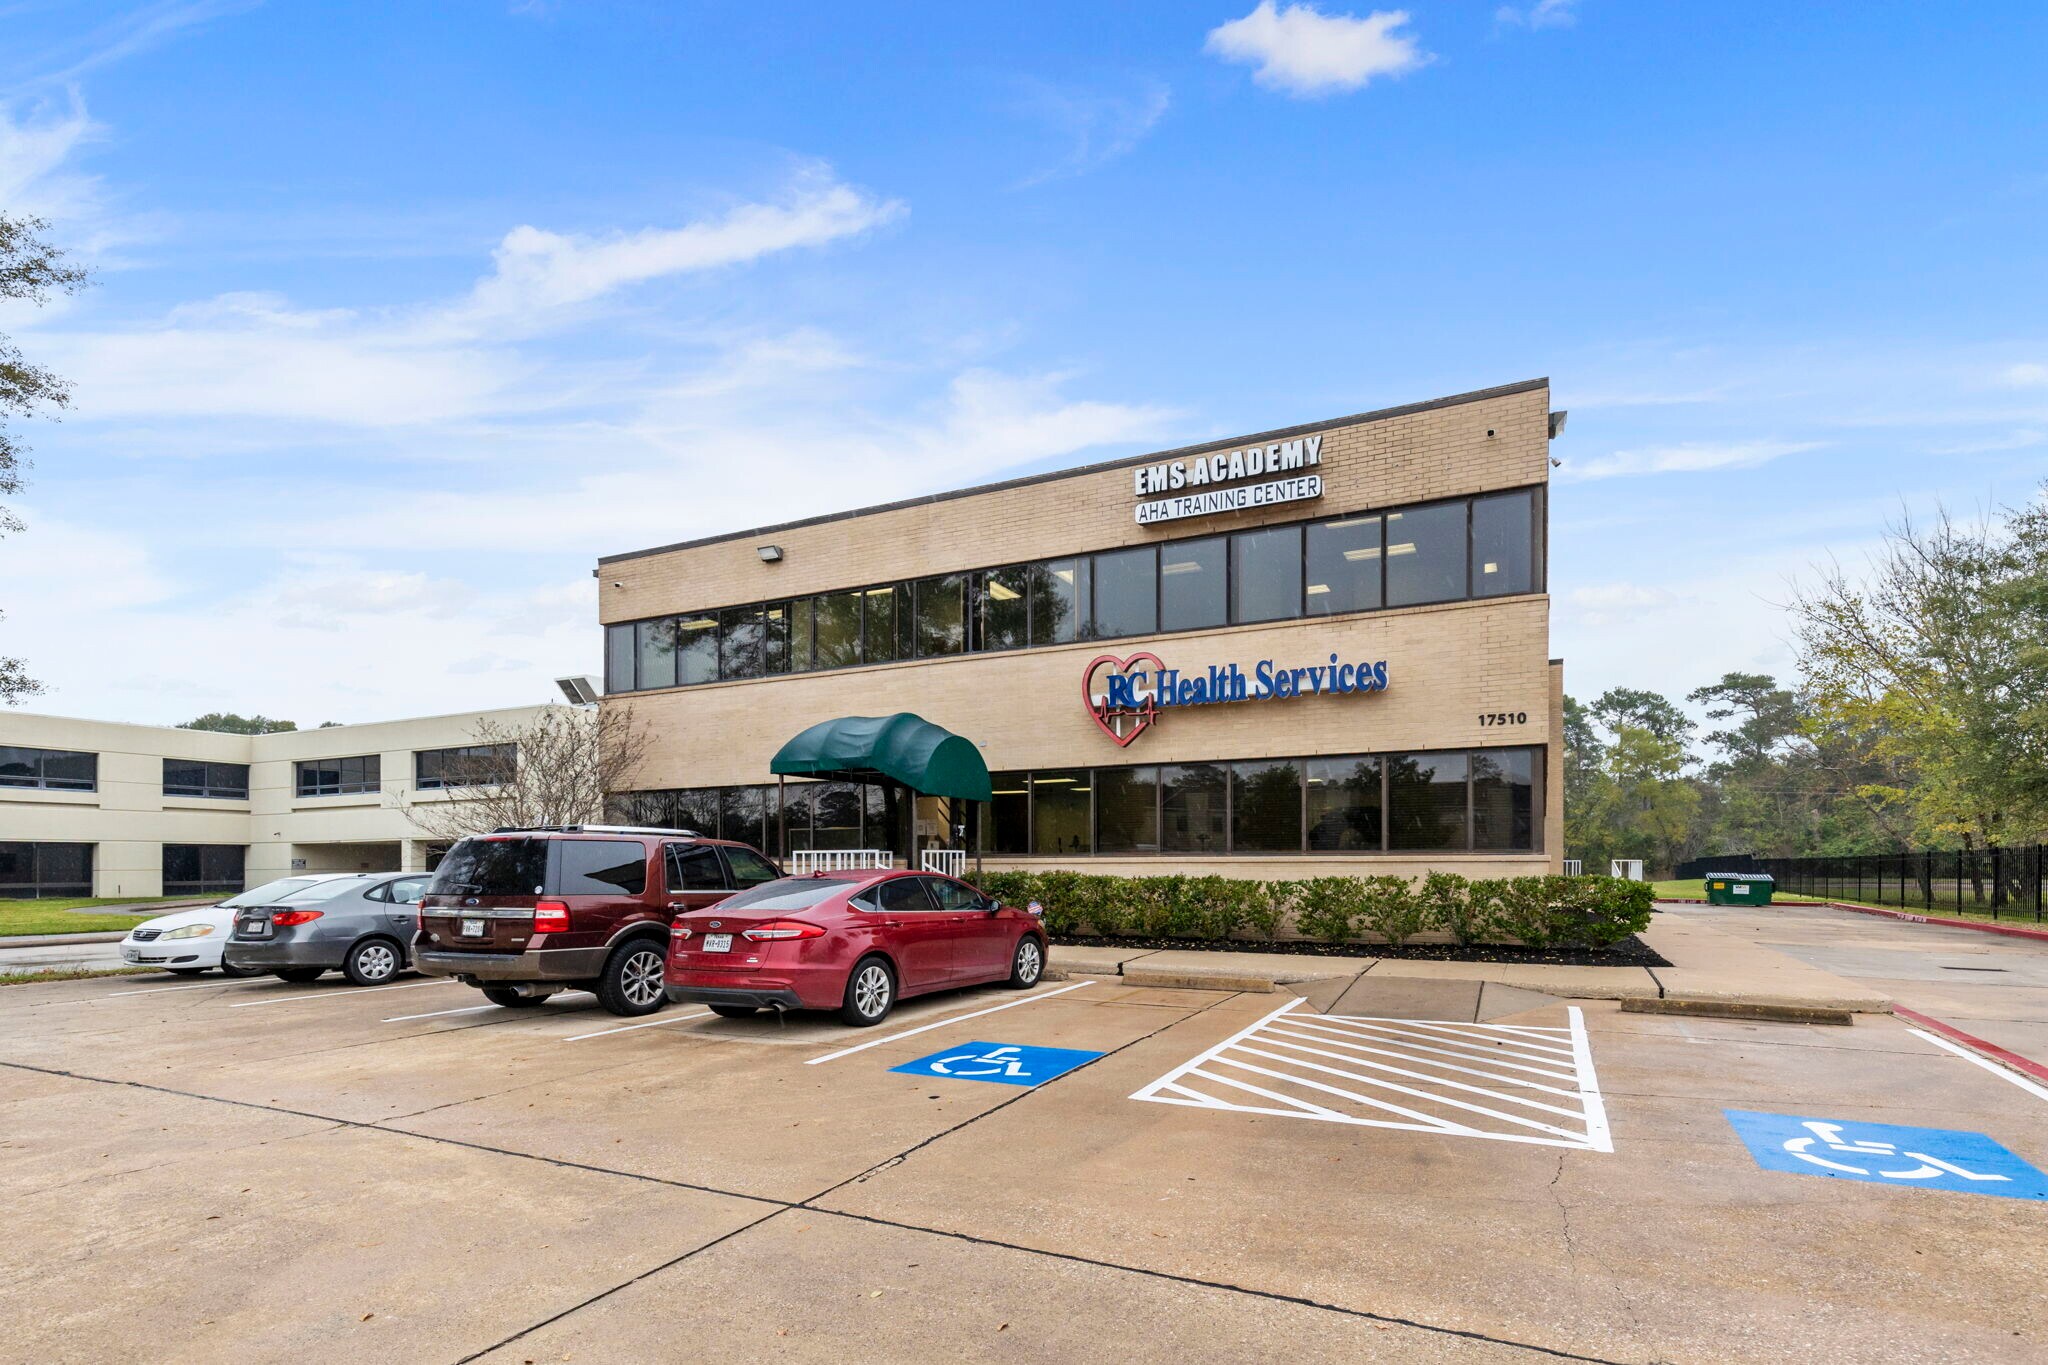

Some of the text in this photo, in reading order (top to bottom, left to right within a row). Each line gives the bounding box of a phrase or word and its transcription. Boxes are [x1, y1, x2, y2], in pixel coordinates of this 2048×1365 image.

[1135, 435, 1322, 497] EMS ACADEMY
[1138, 477, 1318, 523] AHA TRAINING CENTER
[1106, 653, 1388, 708] RC Health Services
[1478, 711, 1527, 726] 17510
